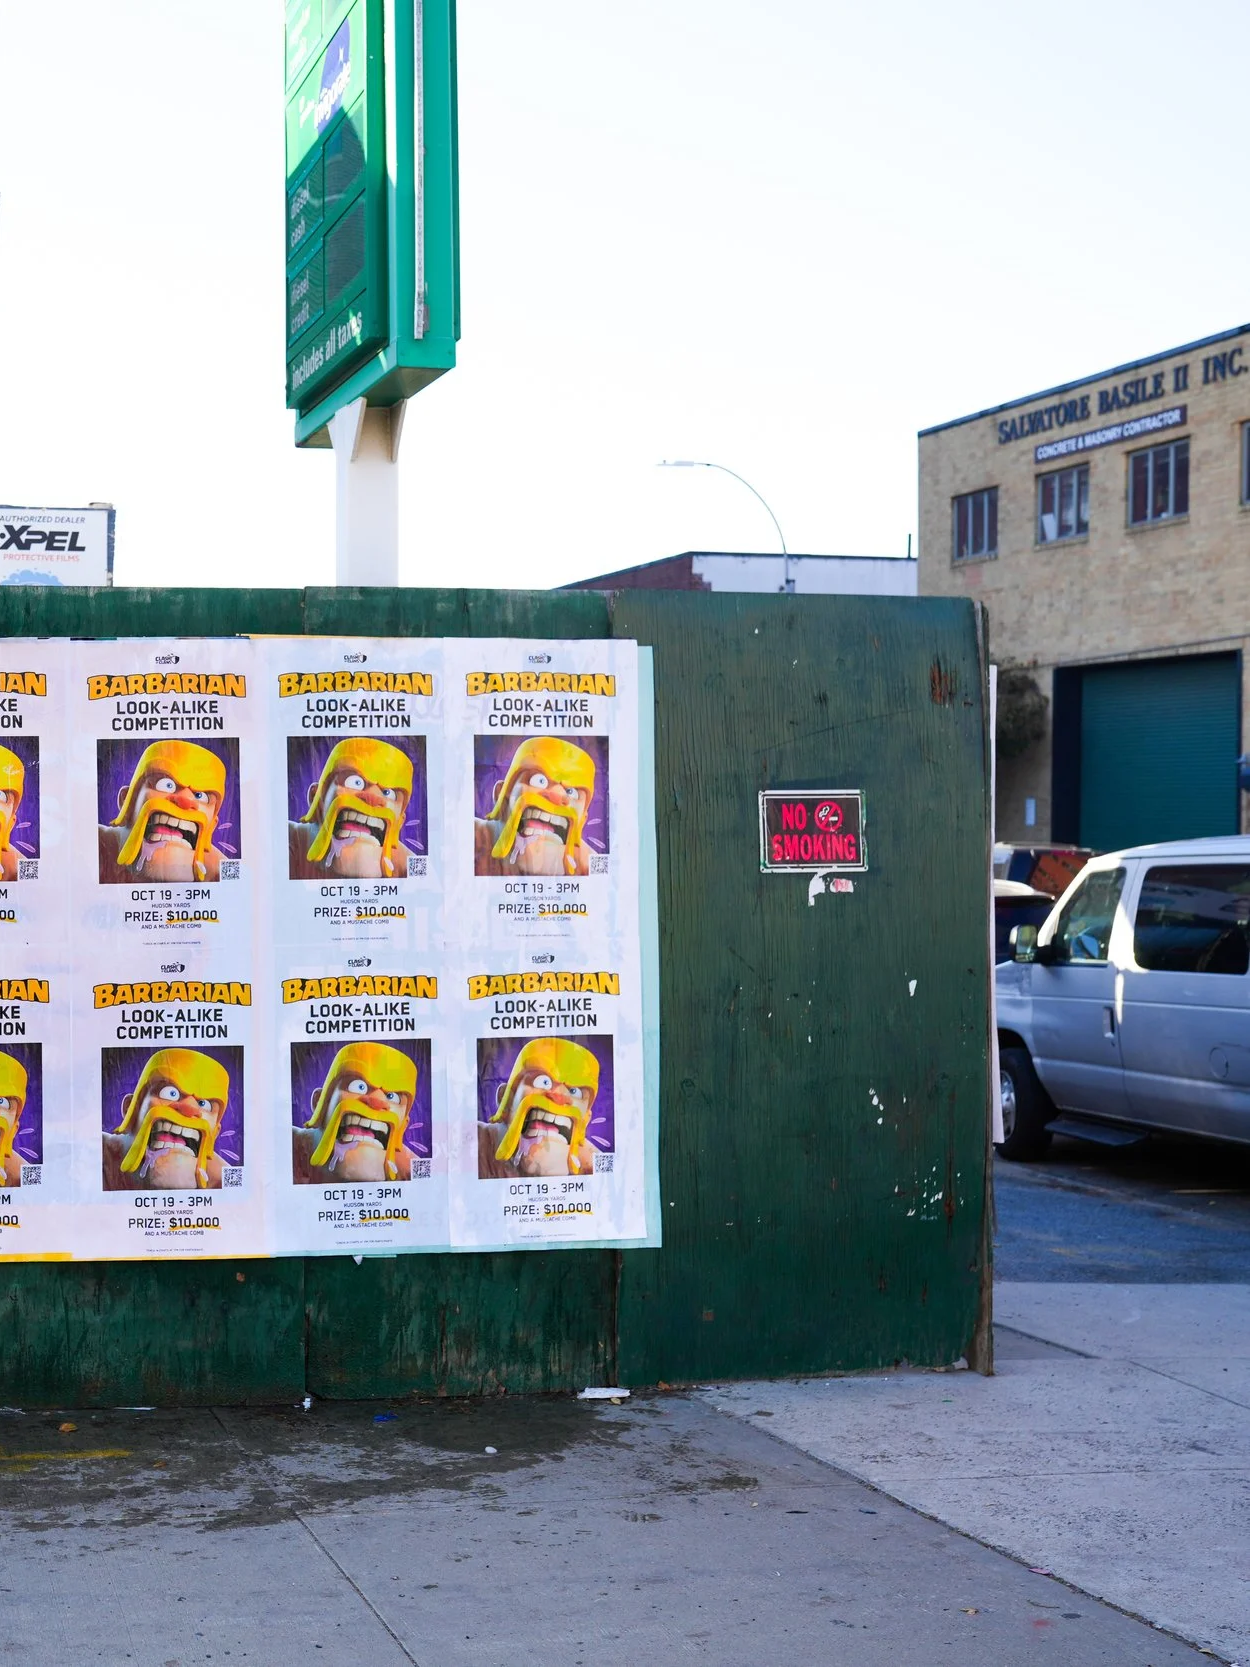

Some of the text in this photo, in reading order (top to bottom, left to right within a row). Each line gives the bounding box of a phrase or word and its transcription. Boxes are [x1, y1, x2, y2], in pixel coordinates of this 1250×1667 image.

[291, 217, 305, 247] cash
[292, 311, 362, 390] includes all taxes
[998, 347, 1248, 444] SALVATORE BASILE II INC.
[1037, 409, 1181, 459] CONCRETE & MASONRY CONTRACTOR
[0, 515, 52, 523] AUTHORIZED
[0, 525, 86, 551] XPEL
[3, 553, 53, 561] PROTECTIVE
[87, 673, 246, 700] BARBARIAN
[278, 671, 433, 697] BARBARIAN
[466, 671, 616, 697] BARBARIAN
[116, 700, 218, 715] LOOK-ALIKE
[307, 698, 406, 712] LOOK-ALIKE
[493, 698, 588, 712] LOOK-ALIKE
[112, 716, 223, 731] COMPETITION
[302, 714, 411, 728] COMPETITION
[489, 714, 593, 728] COMPETITION
[781, 803, 807, 830] NO
[772, 834, 856, 860] SMOKING
[321, 886, 344, 897] OCT
[348, 886, 360, 896] 19
[373, 885, 398, 896] 3PM
[125, 910, 218, 922] PRIZE: $10,000
[314, 906, 405, 918] PRIZE: $10,000
[498, 903, 586, 915] PRIZE: $10,000
[281, 975, 437, 1004] BARBARIAN
[468, 972, 620, 1000] BARBARIAN
[93, 981, 252, 1009] BARBARIAN
[310, 1002, 410, 1018] LOOK-ALIKE
[495, 998, 592, 1014] LOOK-ALIKE
[122, 1008, 223, 1023] LOOK-ALIKE
[490, 1014, 597, 1030] COMPETITION
[116, 1025, 228, 1040] COMPETITION
[305, 1018, 415, 1034] COMPETITION
[318, 1208, 410, 1221] PRIZE: $10,000
[504, 1202, 591, 1216] PRIZE: $10,000
[128, 1217, 219, 1229] PRIZE: $10,000
